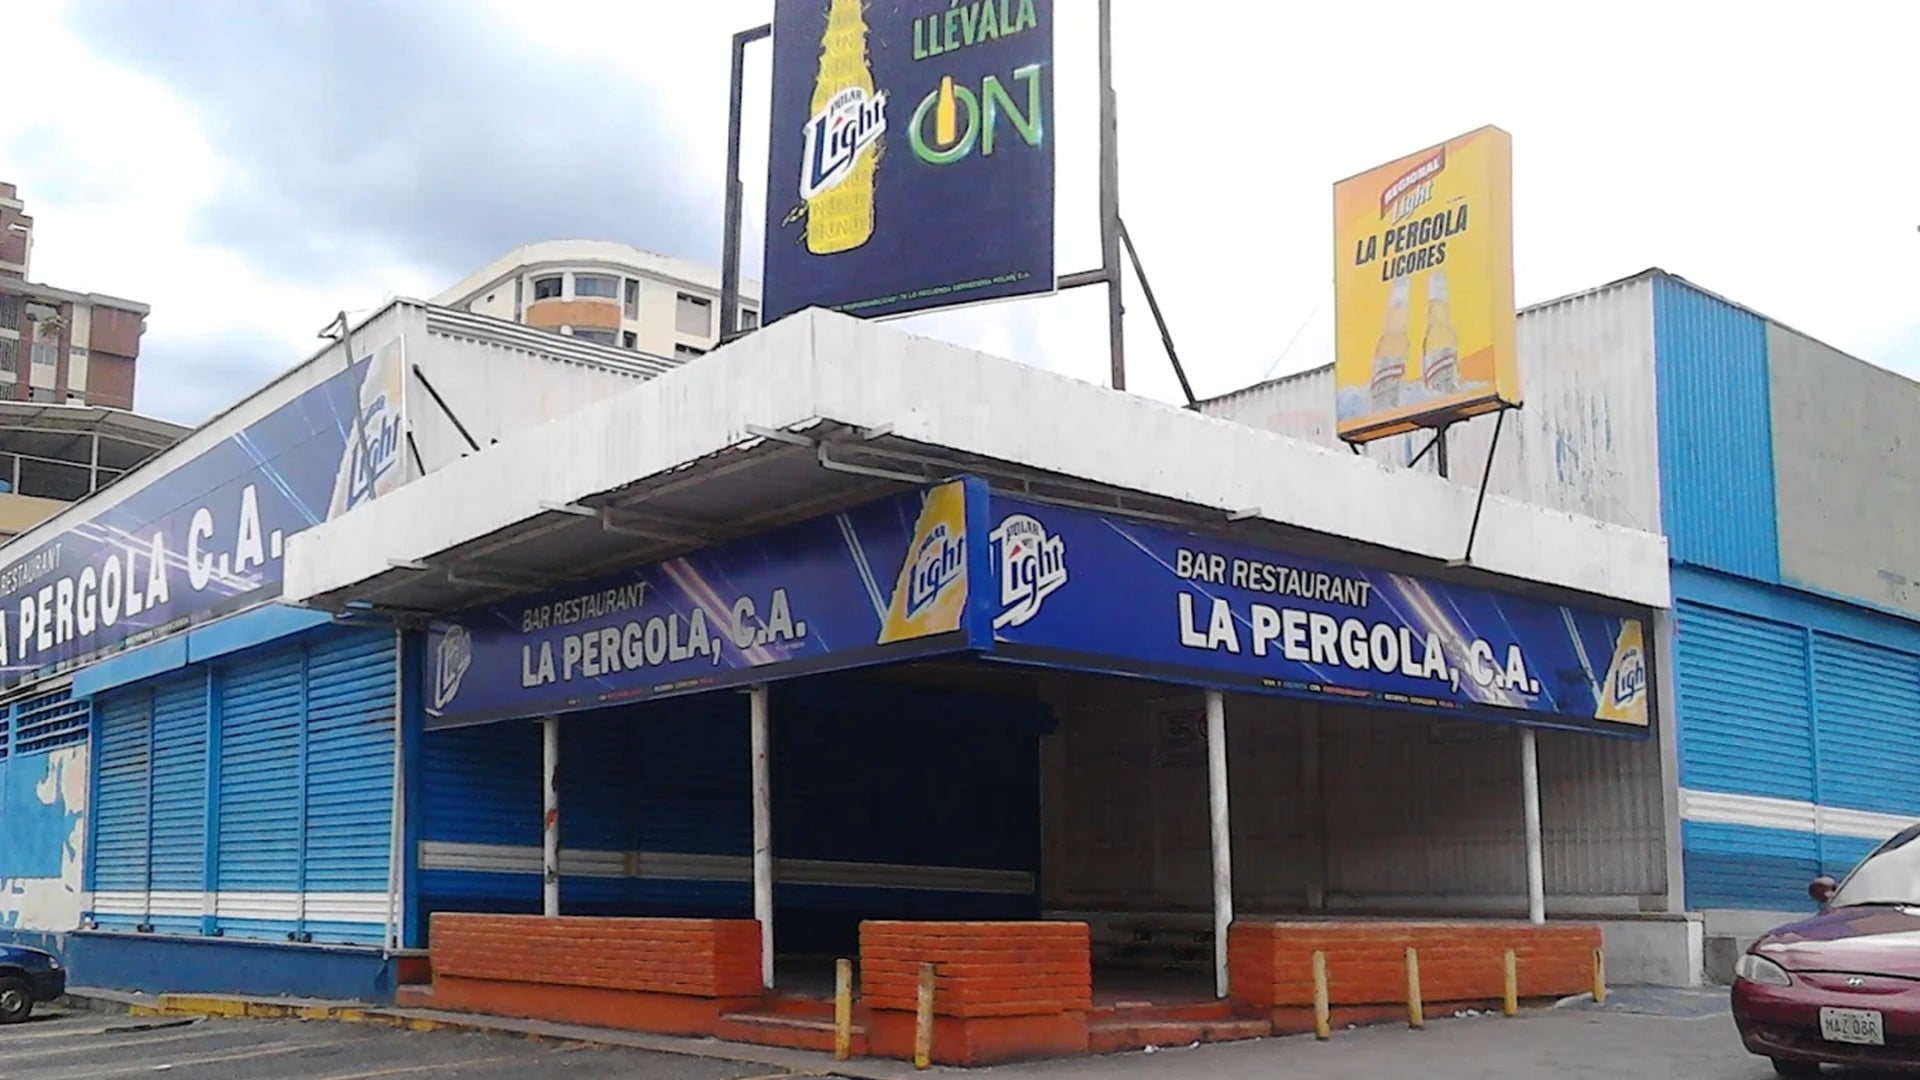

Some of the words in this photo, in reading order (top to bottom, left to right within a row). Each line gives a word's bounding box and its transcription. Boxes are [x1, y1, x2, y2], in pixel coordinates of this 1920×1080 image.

[913, 0, 1037, 60] LLÉVALA
[908, 63, 1042, 164] ON
[810, 100, 881, 190] Light
[1384, 158, 1440, 205] REGIONAL
[1392, 180, 1433, 226] Light
[1356, 234, 1377, 266] LA
[1382, 203, 1468, 258] PERGOLA
[1382, 241, 1446, 282] LICORES
[1006, 521, 1040, 545] POLAR
[19, 531, 169, 660] PERGOLA
[188, 485, 282, 591] C.A.
[906, 536, 963, 618] Light
[1177, 549, 1226, 585] BAR
[1232, 559, 1371, 608] RESTAURANT
[522, 605, 550, 633] BAR
[553, 581, 647, 625] RESTAURANT
[522, 641, 556, 687] LA
[563, 607, 721, 681] PERGOLA,
[732, 588, 806, 649] C.A.
[1179, 593, 1240, 653] LA
[1251, 603, 1460, 693] PERGOLA,
[1470, 639, 1540, 694] C.A.
[1615, 660, 1646, 704] Ligh
